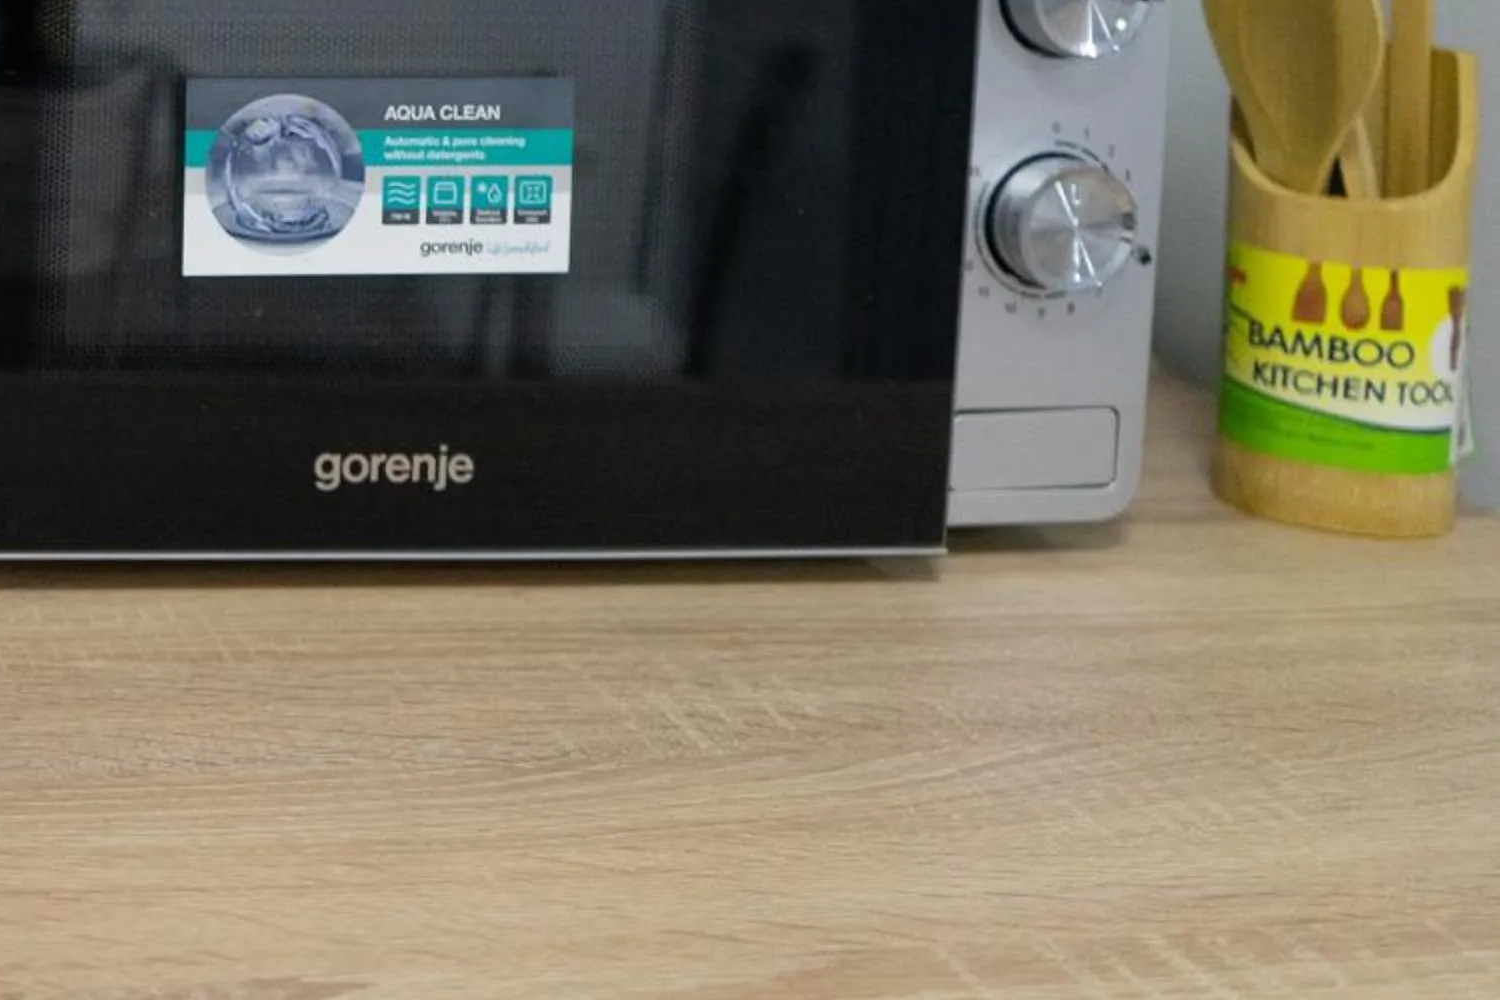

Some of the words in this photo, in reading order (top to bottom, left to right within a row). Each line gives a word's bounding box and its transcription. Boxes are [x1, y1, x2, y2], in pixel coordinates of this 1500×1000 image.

[384, 104, 436, 120] AQUA
[439, 104, 500, 120] CLEAN
[384, 136, 439, 147] Automatic
[480, 136, 526, 148] cleaning
[384, 150, 424, 160] without
[427, 150, 485, 162] detergents
[420, 238, 484, 256] gorenje
[1249, 319, 1415, 369] BAMBOO
[1252, 361, 1386, 404] KITCHEN
[314, 443, 474, 492] gorenje
